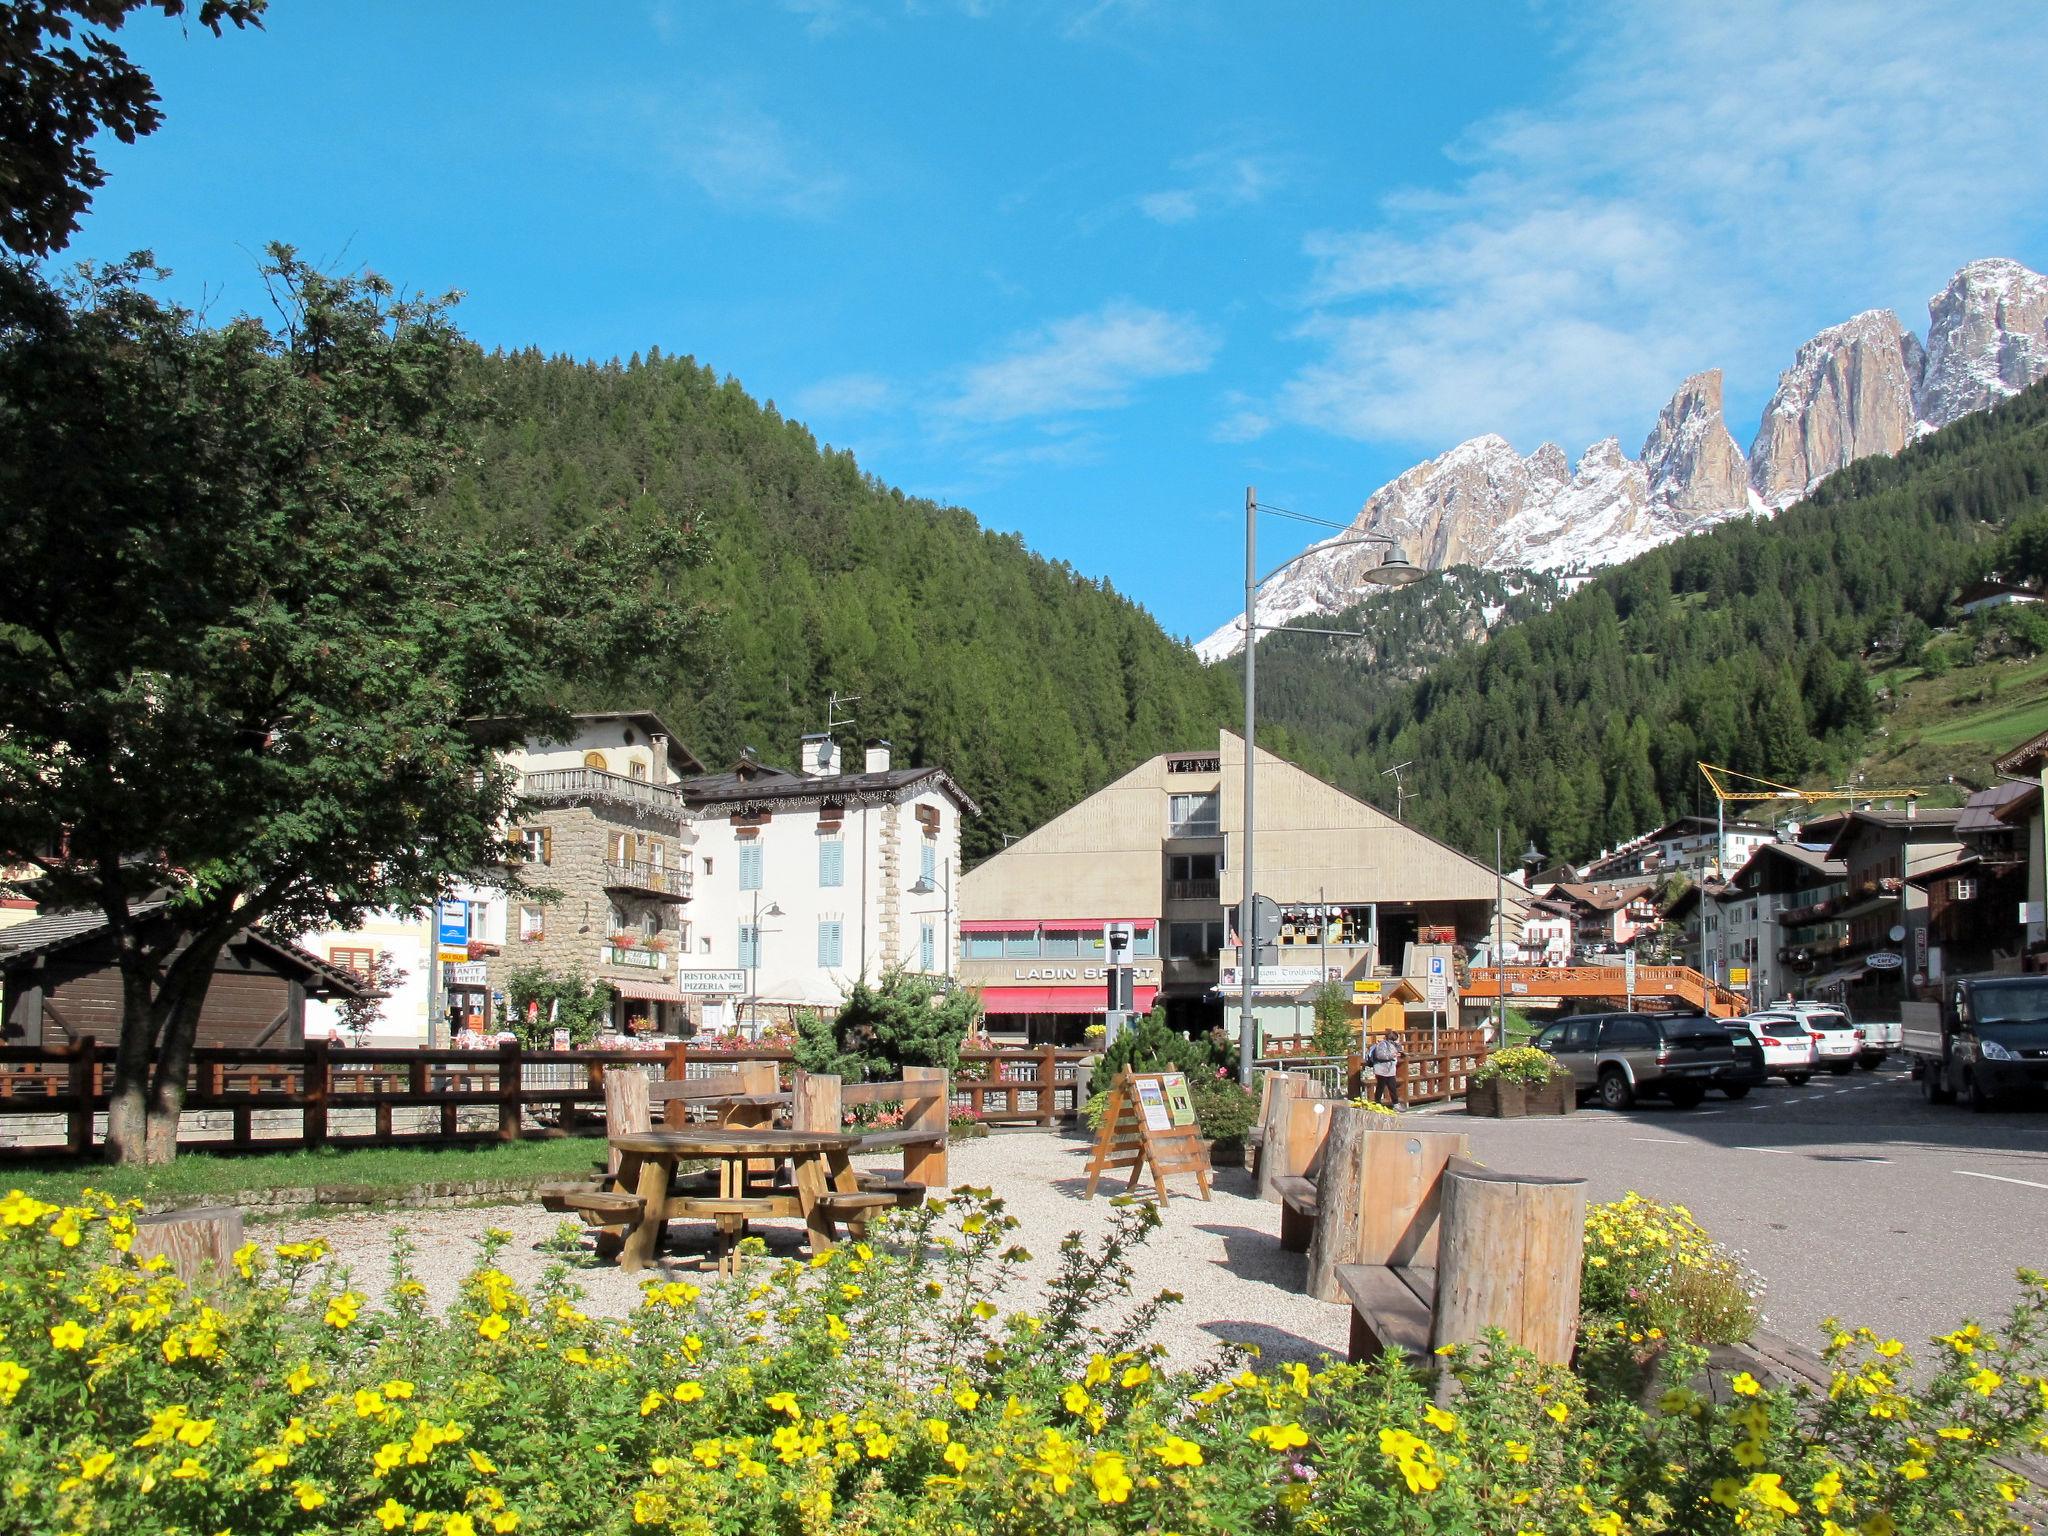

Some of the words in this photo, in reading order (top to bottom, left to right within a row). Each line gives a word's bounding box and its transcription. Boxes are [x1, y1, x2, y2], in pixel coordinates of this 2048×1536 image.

[1433, 960, 1440, 971] P
[1015, 968, 1077, 979] LADIN
[1084, 967, 1154, 979] SPRT
